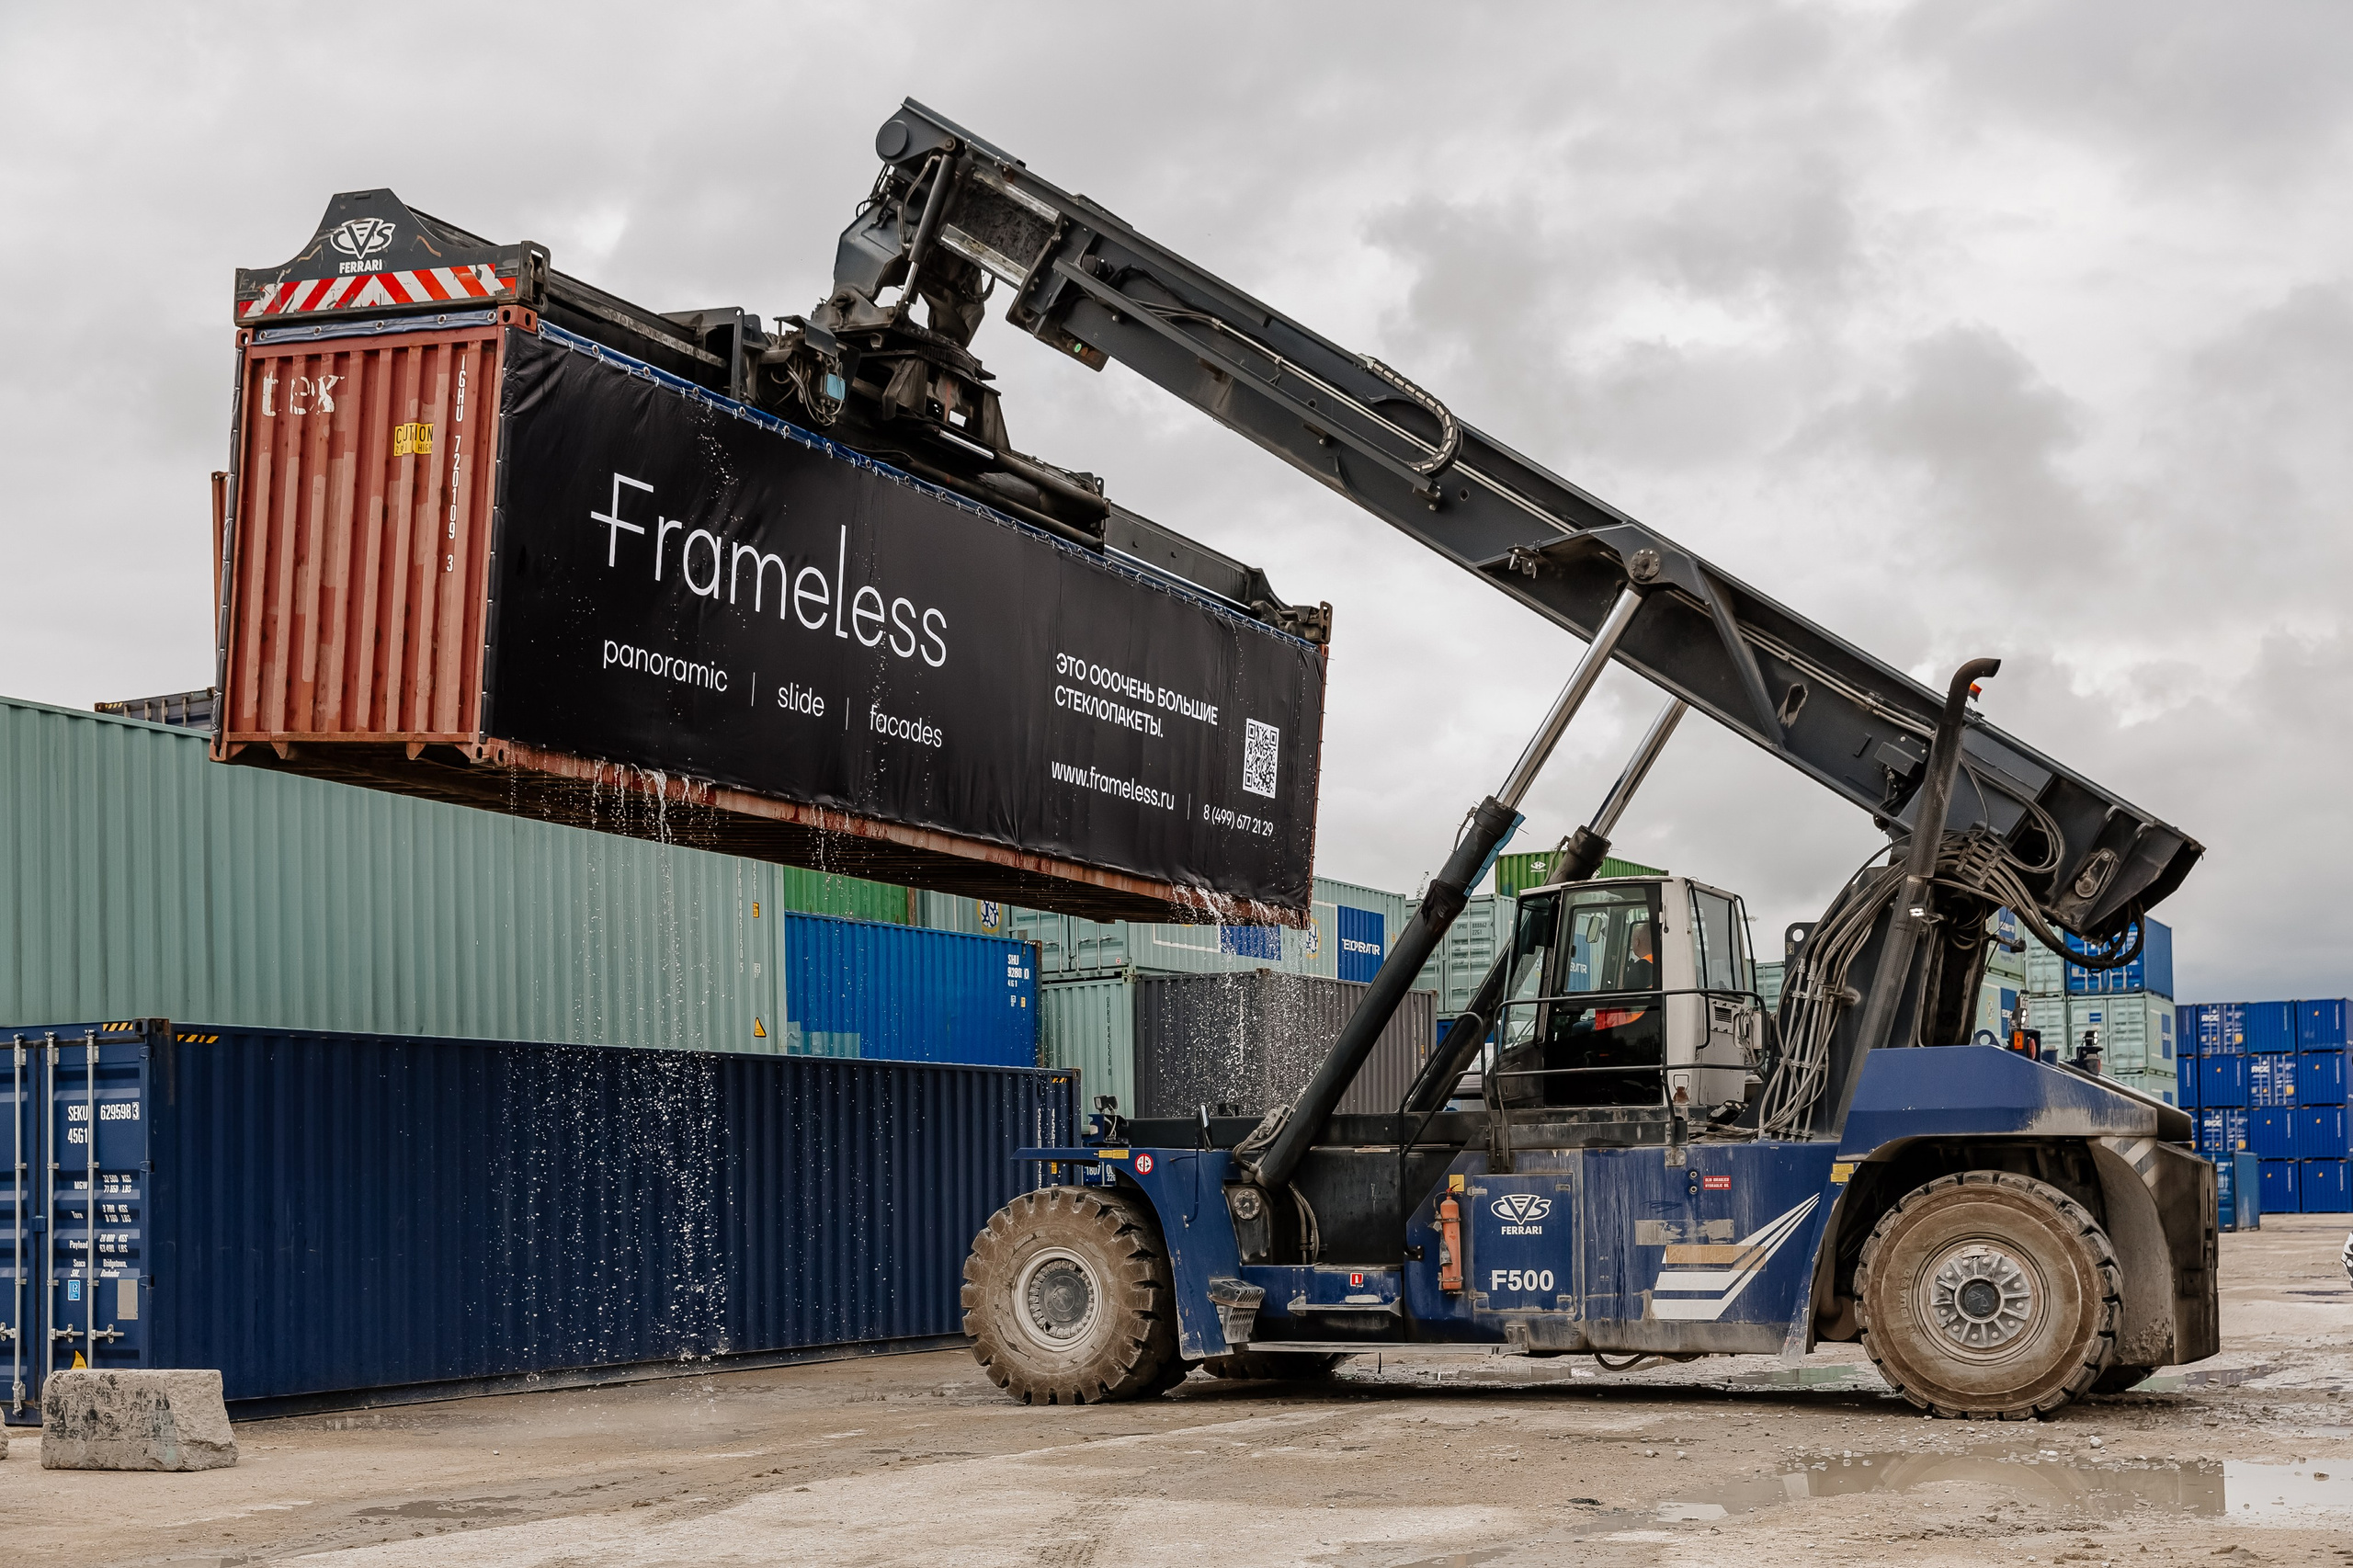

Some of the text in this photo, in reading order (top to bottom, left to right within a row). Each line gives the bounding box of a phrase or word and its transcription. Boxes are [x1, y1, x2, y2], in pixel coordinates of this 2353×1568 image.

[339, 259, 383, 274] FERRARI
[449, 435, 462, 540] 720109
[446, 553, 454, 572] 3
[590, 472, 948, 667] Frameless
[603, 639, 942, 747] panoramic slide facades
[1056, 653, 1218, 726] ЭТО ОООЧЕНЬ БОЛЬШИЕ
[1054, 685, 1164, 738] СТЕКЛОПАКЕТЫ.
[1051, 761, 1175, 811] www.frameless.ru
[1203, 804, 1274, 837] 8 (499) 677 21 29
[67, 1102, 140, 1121] SEKU 629598 3
[67, 1128, 88, 1143] 45G1
[1491, 1194, 1552, 1225] CVS
[69, 1240, 88, 1250] Payload
[1501, 1225, 1542, 1235] FERRARI
[1491, 1269, 1554, 1291] F500
